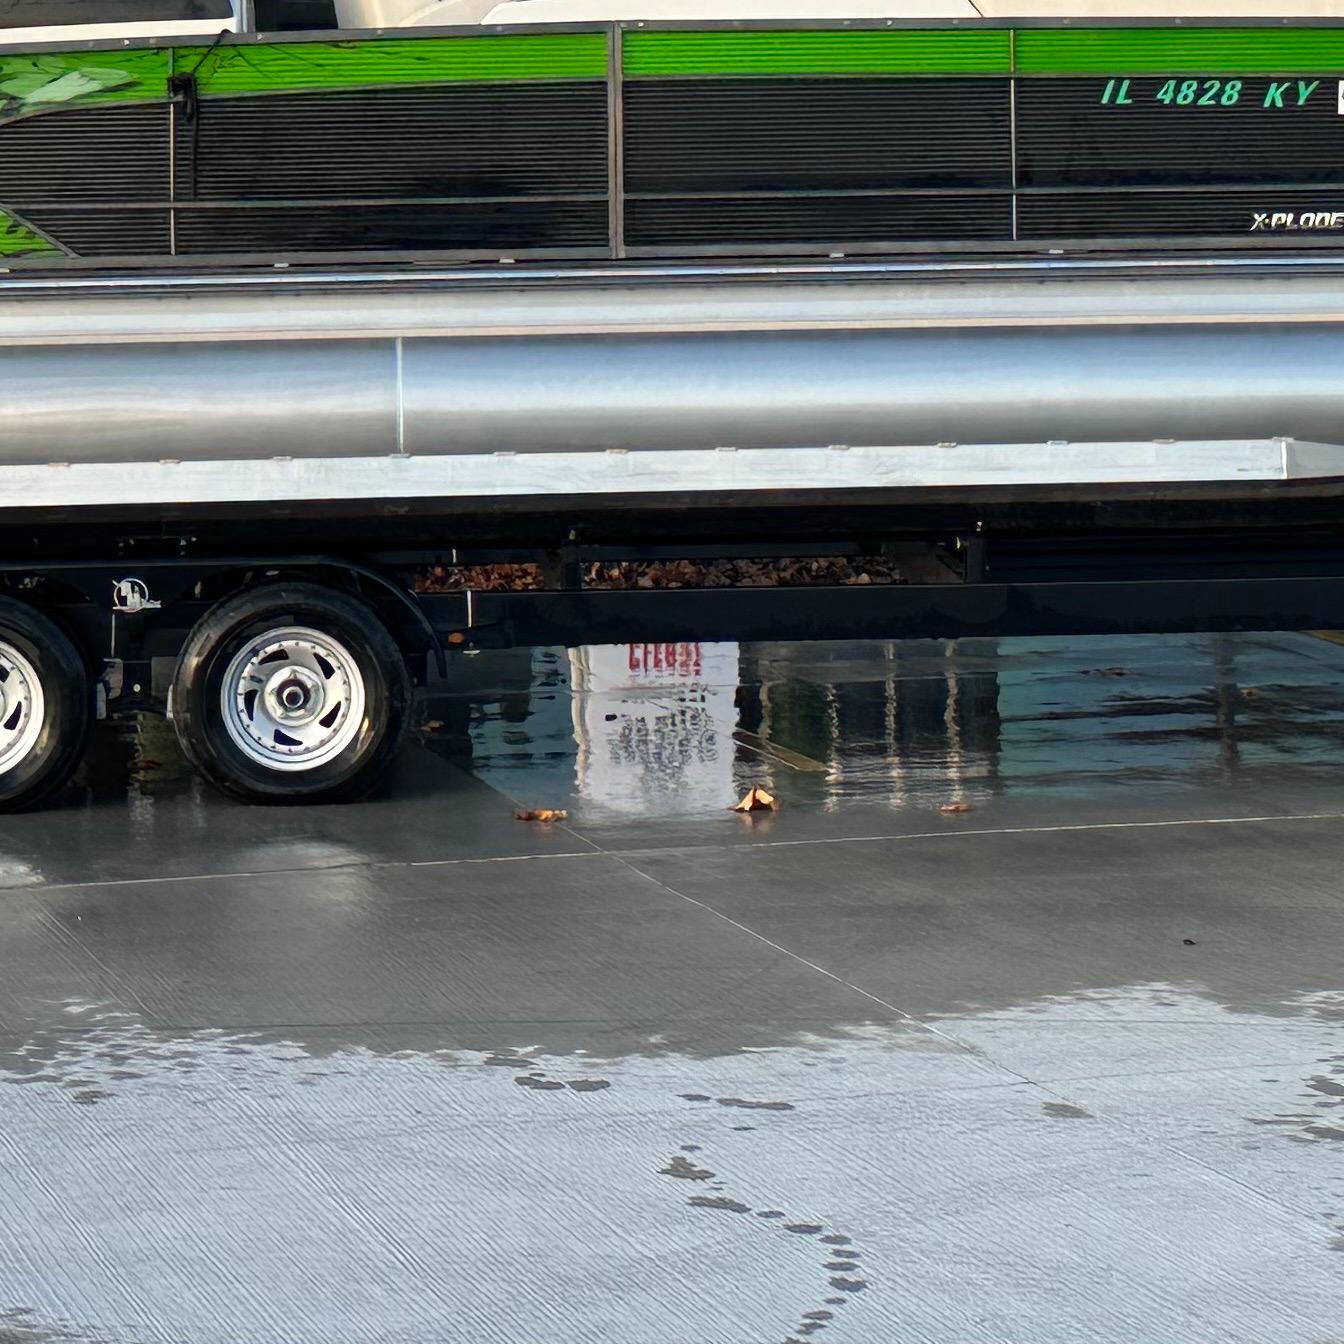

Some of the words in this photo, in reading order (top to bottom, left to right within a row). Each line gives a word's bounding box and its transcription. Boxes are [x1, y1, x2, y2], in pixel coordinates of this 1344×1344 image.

[1100, 79, 1134, 104] IL
[1156, 79, 1242, 106] 4828
[1263, 80, 1320, 107] KY
